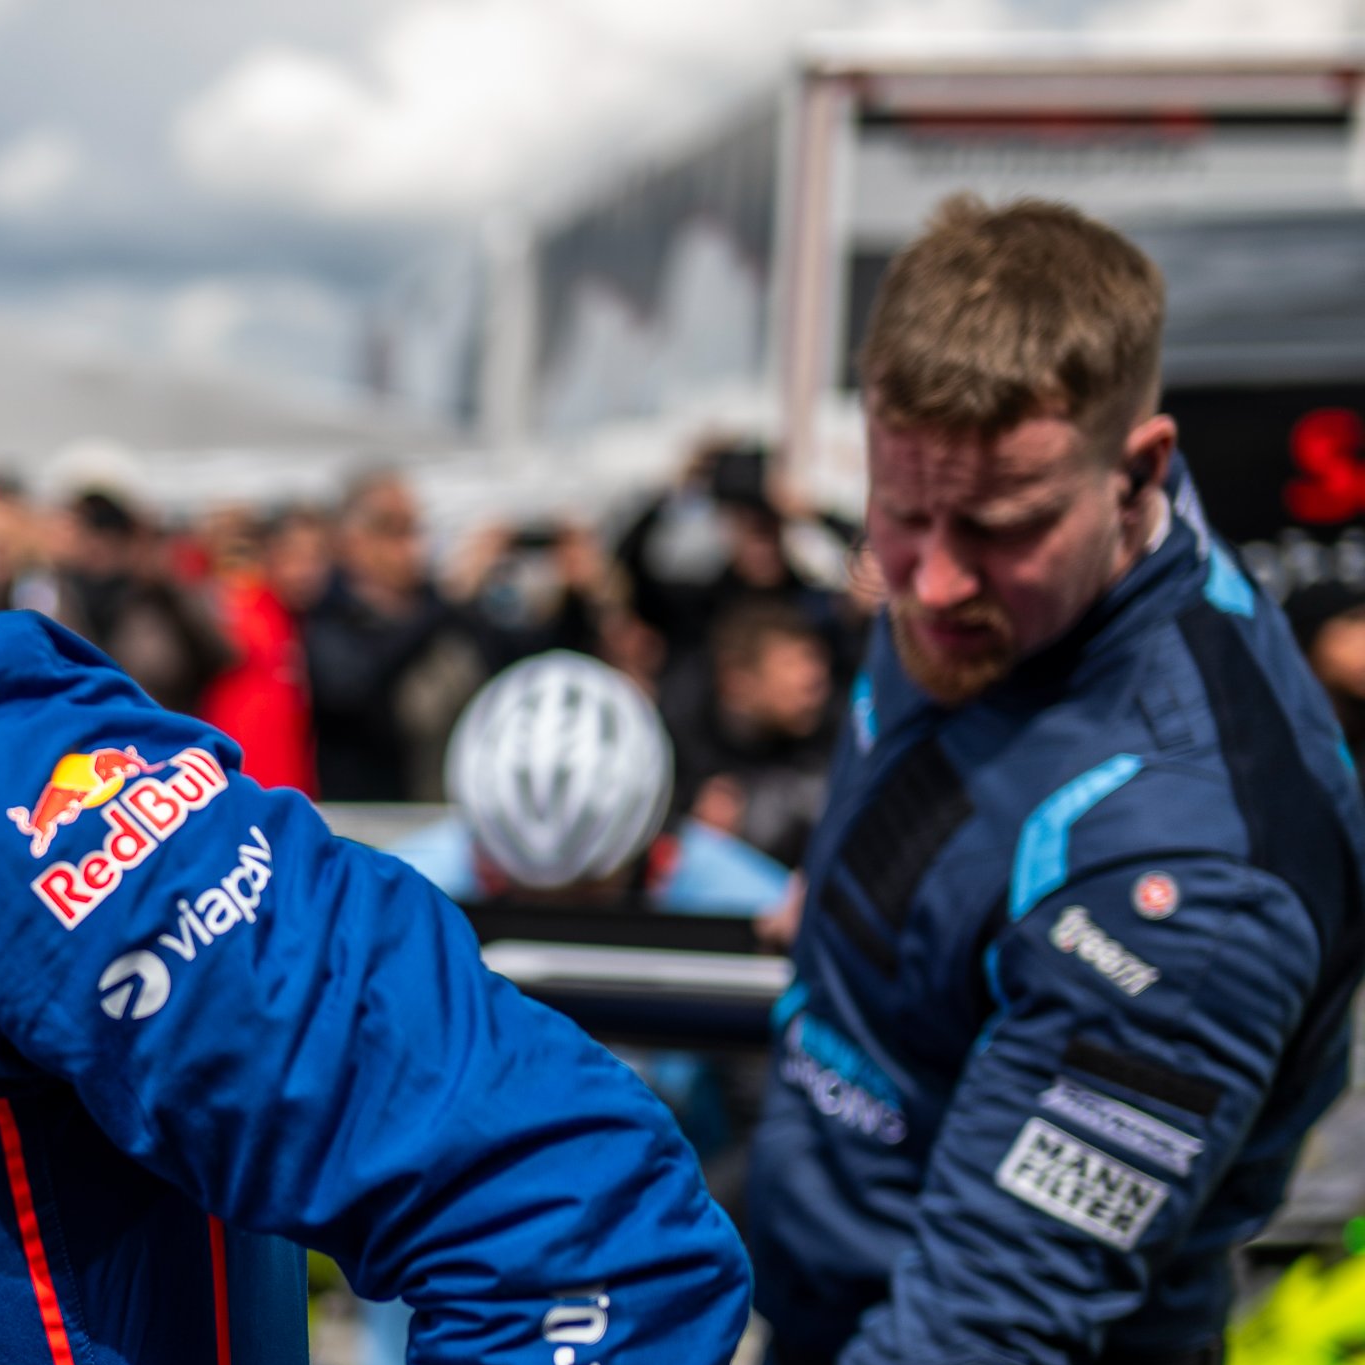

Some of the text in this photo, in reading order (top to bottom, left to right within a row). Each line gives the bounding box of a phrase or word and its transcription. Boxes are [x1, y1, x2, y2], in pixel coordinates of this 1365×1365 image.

[31, 748, 229, 929] Red Bull
[1014, 1160, 1135, 1235] FILTER
[1030, 1133, 1155, 1210] MANN
